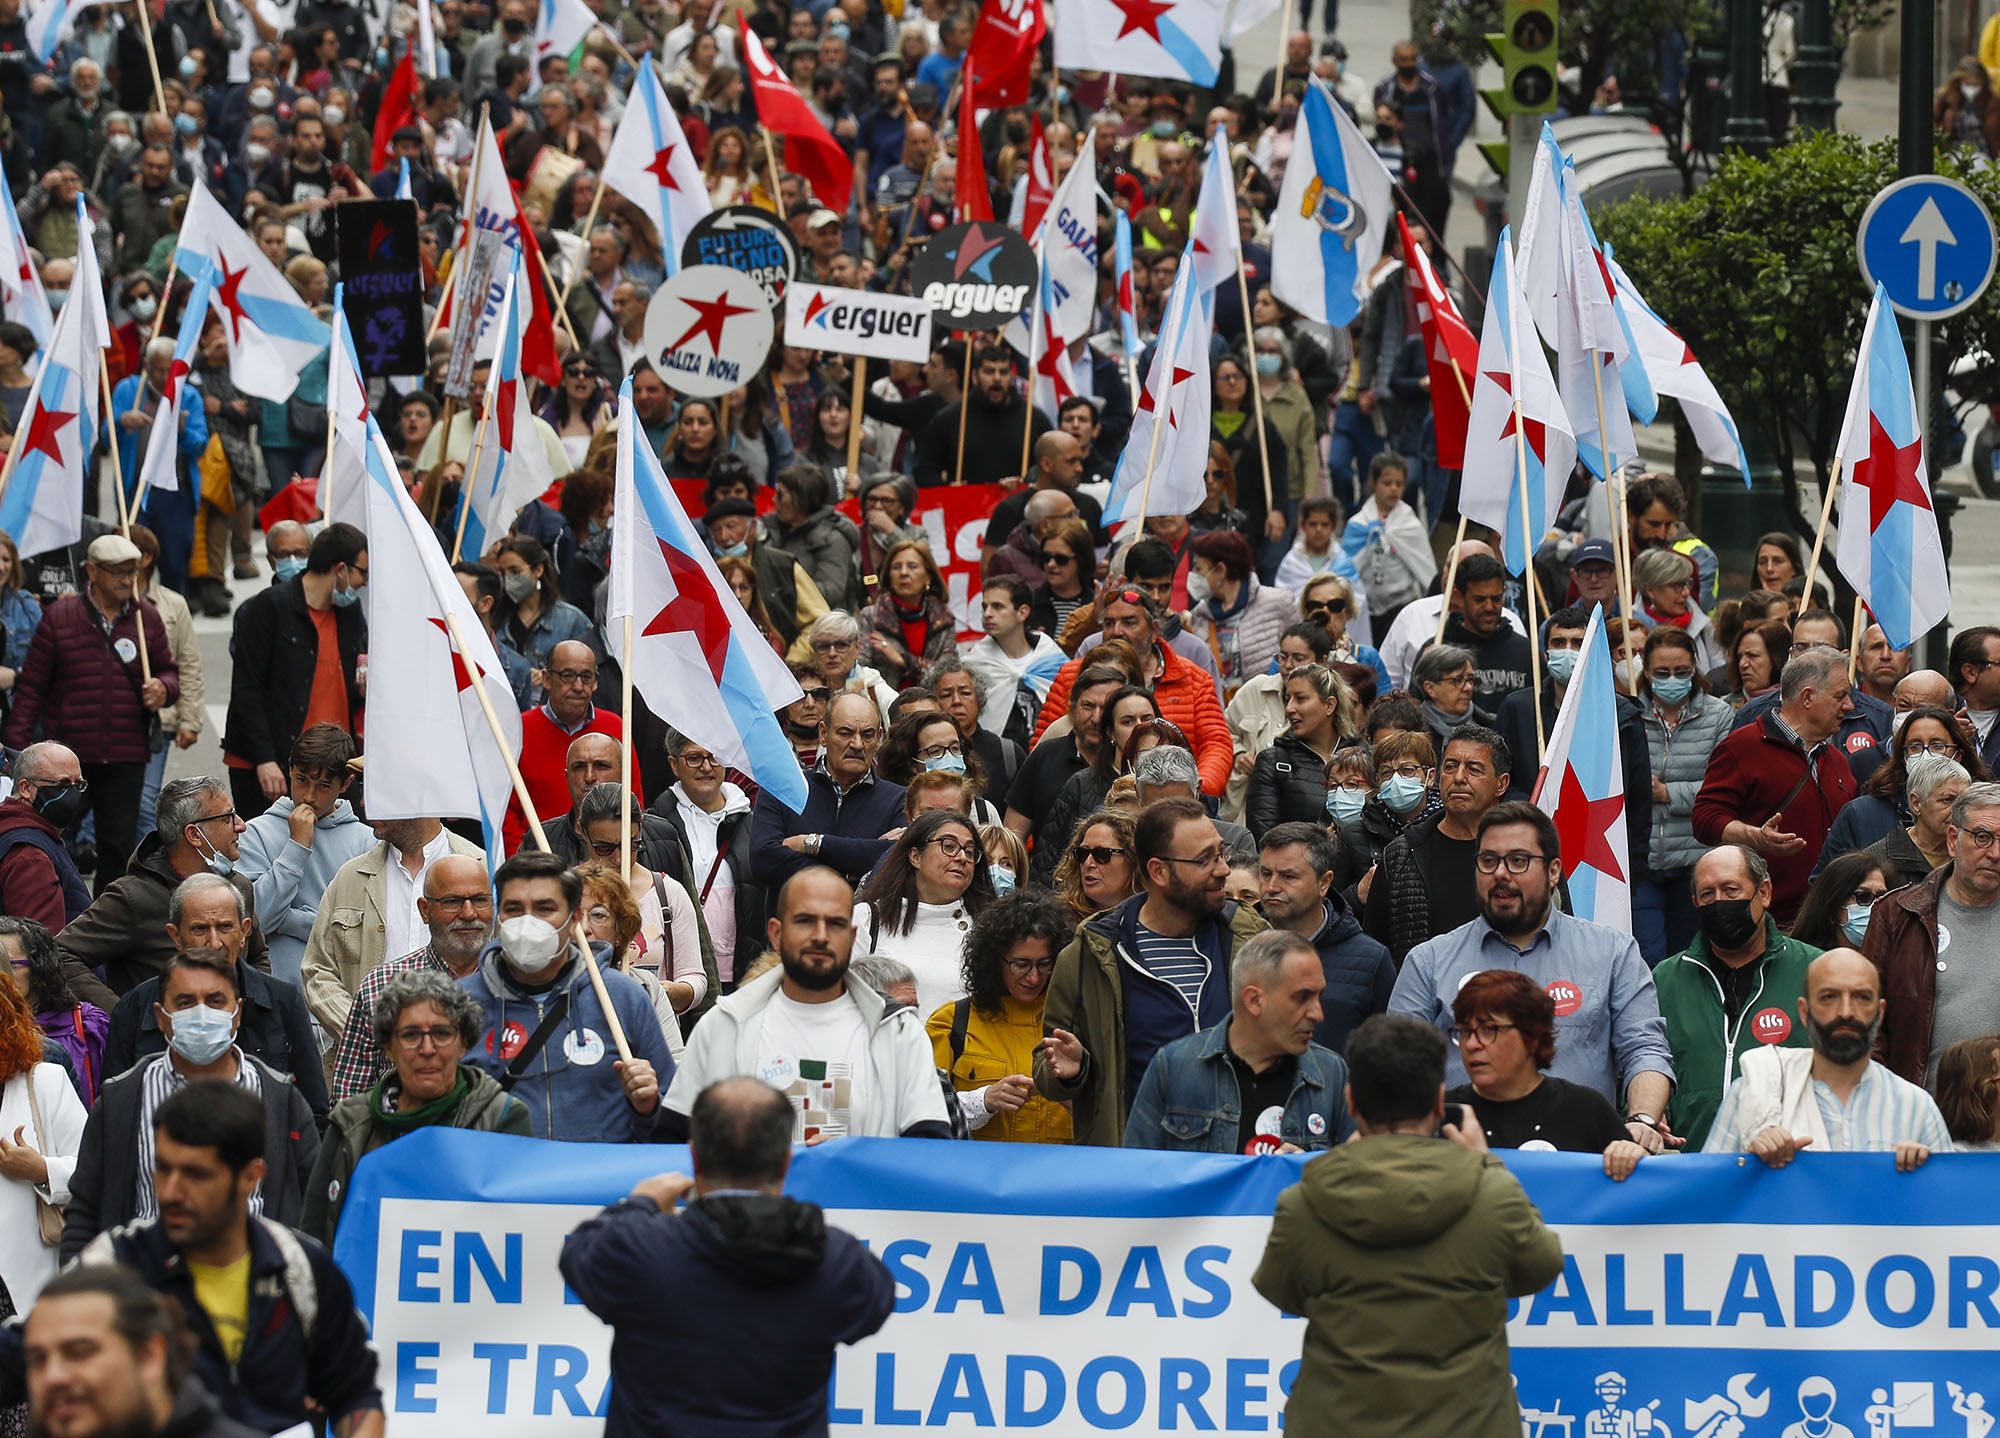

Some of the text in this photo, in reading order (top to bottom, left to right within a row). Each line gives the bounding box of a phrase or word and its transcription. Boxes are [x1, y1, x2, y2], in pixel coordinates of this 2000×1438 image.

[922, 282, 1030, 318] erguer
[832, 305, 926, 338] erguer
[660, 346, 740, 383] GALIZA NOVA
[1759, 1014, 1784, 1029] CIG
[399, 1229, 523, 1305] EN
[1039, 1245, 1233, 1319] DAS
[395, 1341, 440, 1413] E
